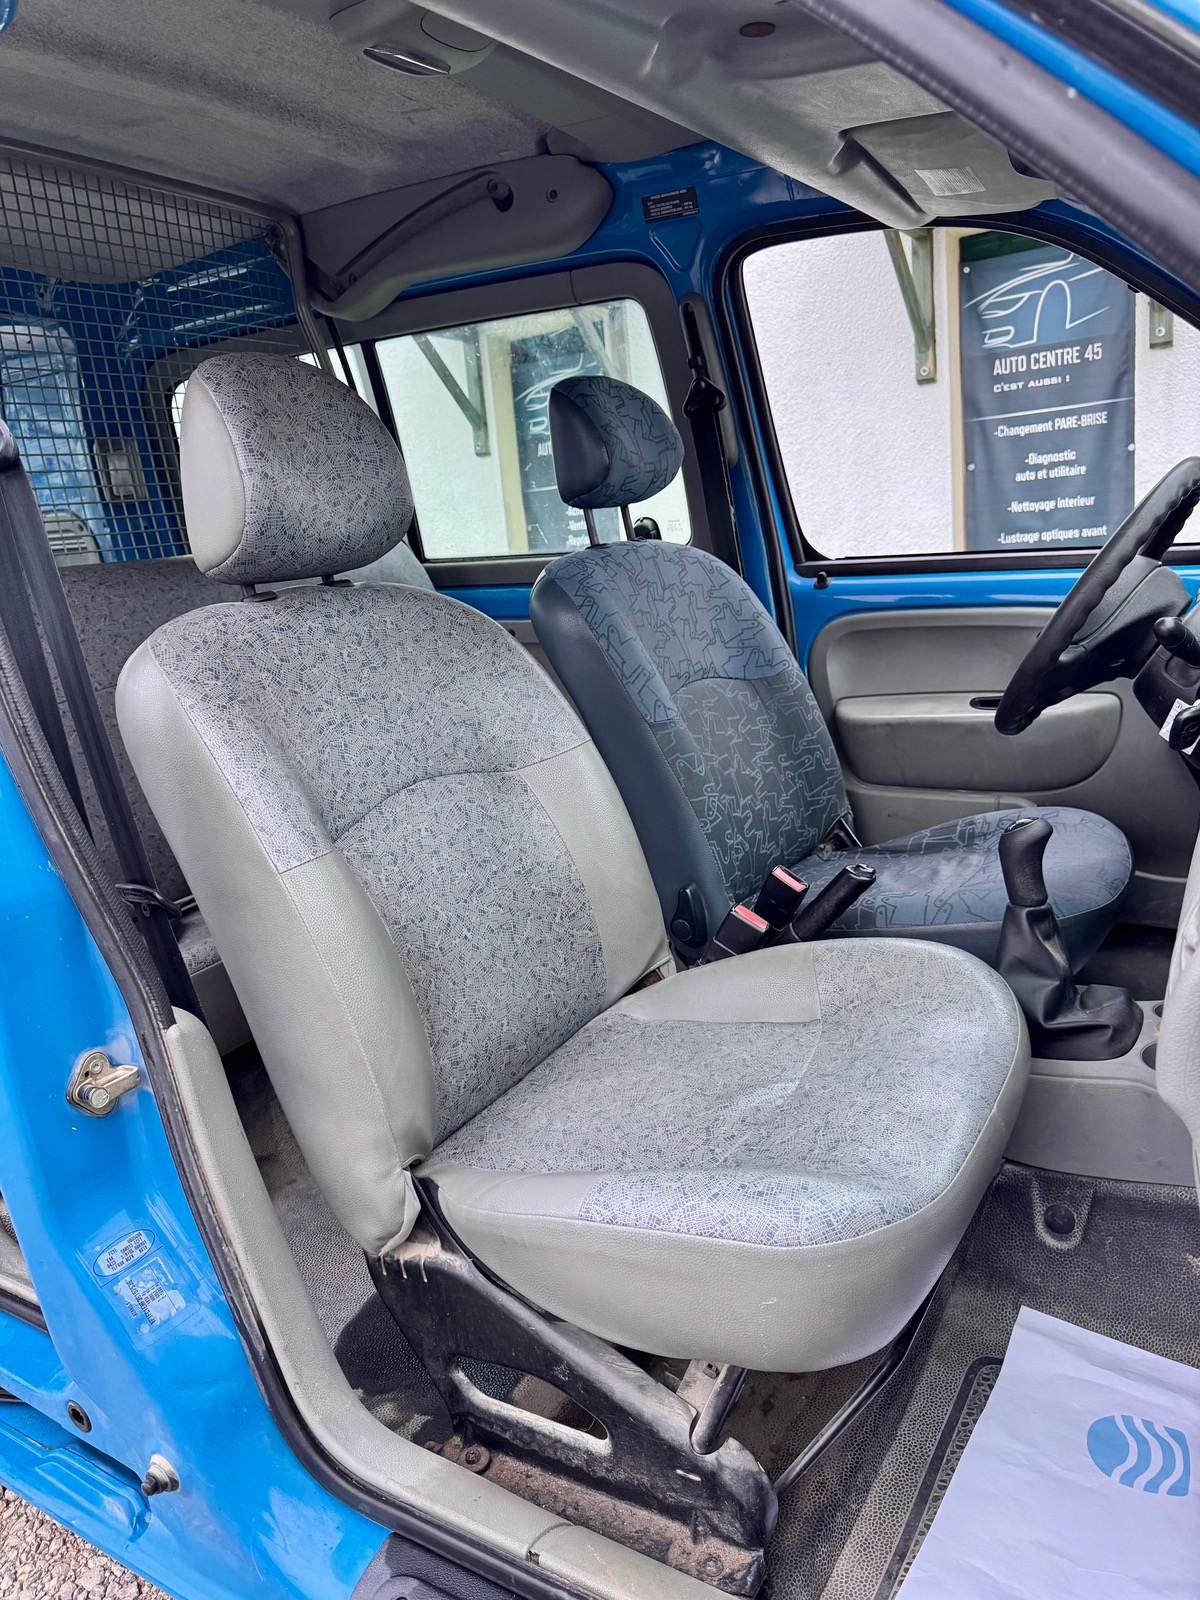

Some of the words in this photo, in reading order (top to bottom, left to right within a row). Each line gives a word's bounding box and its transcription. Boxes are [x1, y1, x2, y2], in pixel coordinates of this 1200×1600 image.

[993, 355, 1027, 376] AUTO
[1030, 346, 1081, 370] CENTRE
[1084, 342, 1103, 361] 45
[993, 382, 1025, 393] C'EST
[1028, 376, 1062, 388] AUSSI
[994, 420, 1053, 437] -Changement
[1054, 411, 1108, 430] PARE-BRISE
[537, 442, 552, 457] AUT
[1024, 449, 1077, 465] -Diagnostic
[1015, 470, 1036, 482] auto
[1037, 468, 1048, 480] et
[1049, 464, 1087, 478] utilitaire
[1007, 500, 1056, 513] -Nettoyage
[1057, 495, 1096, 509] interieur
[997, 532, 1040, 544] -Lustrage
[1041, 528, 1080, 542] optiques
[1081, 524, 1108, 538] avant
